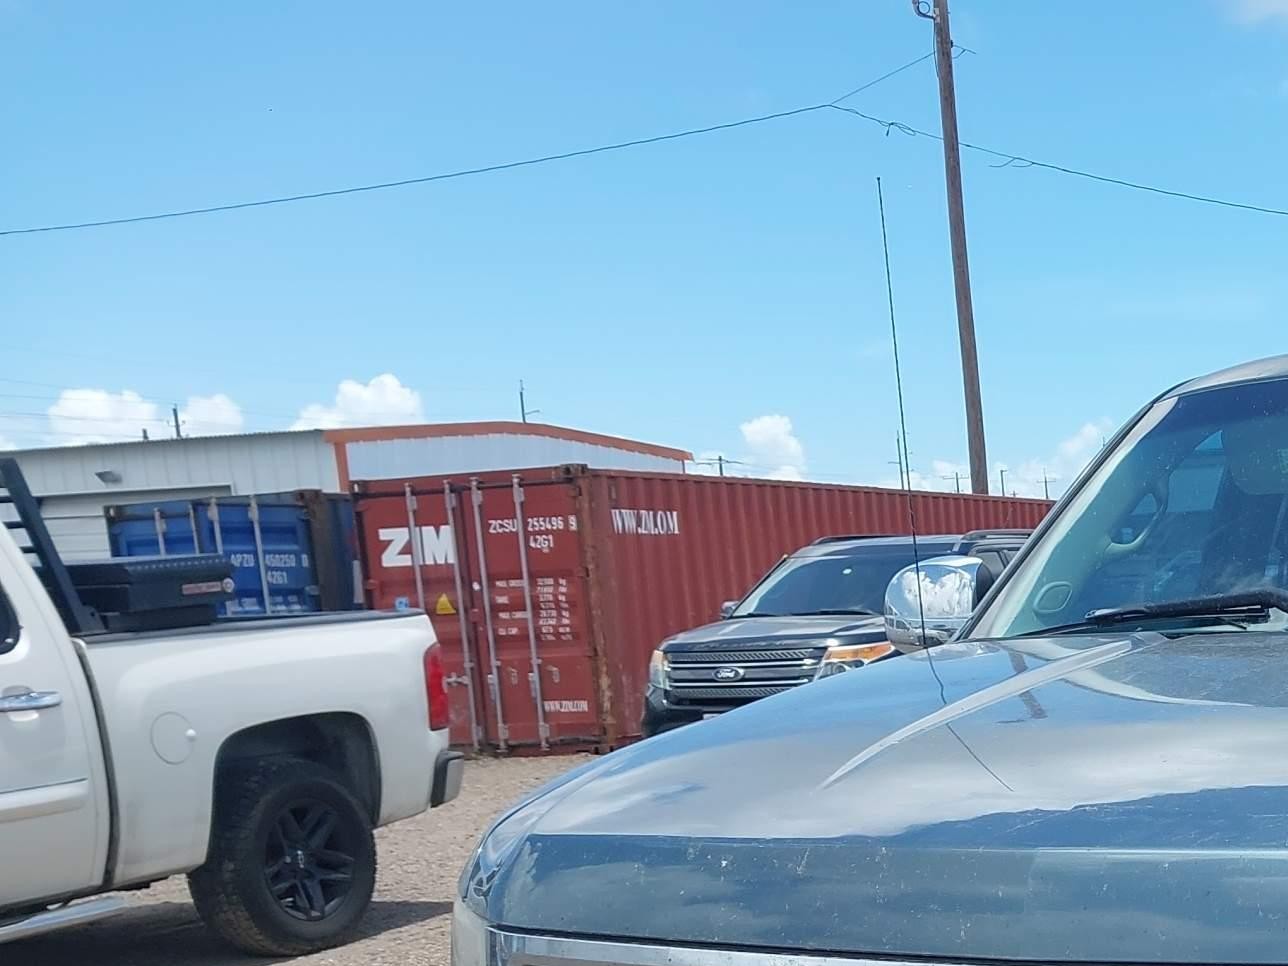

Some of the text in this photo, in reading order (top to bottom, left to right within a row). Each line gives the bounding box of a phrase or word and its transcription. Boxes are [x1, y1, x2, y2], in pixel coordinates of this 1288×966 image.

[488, 515, 577, 533] ZCSU 255496 9
[377, 525, 456, 567] ZIM
[529, 534, 554, 548] 42G1
